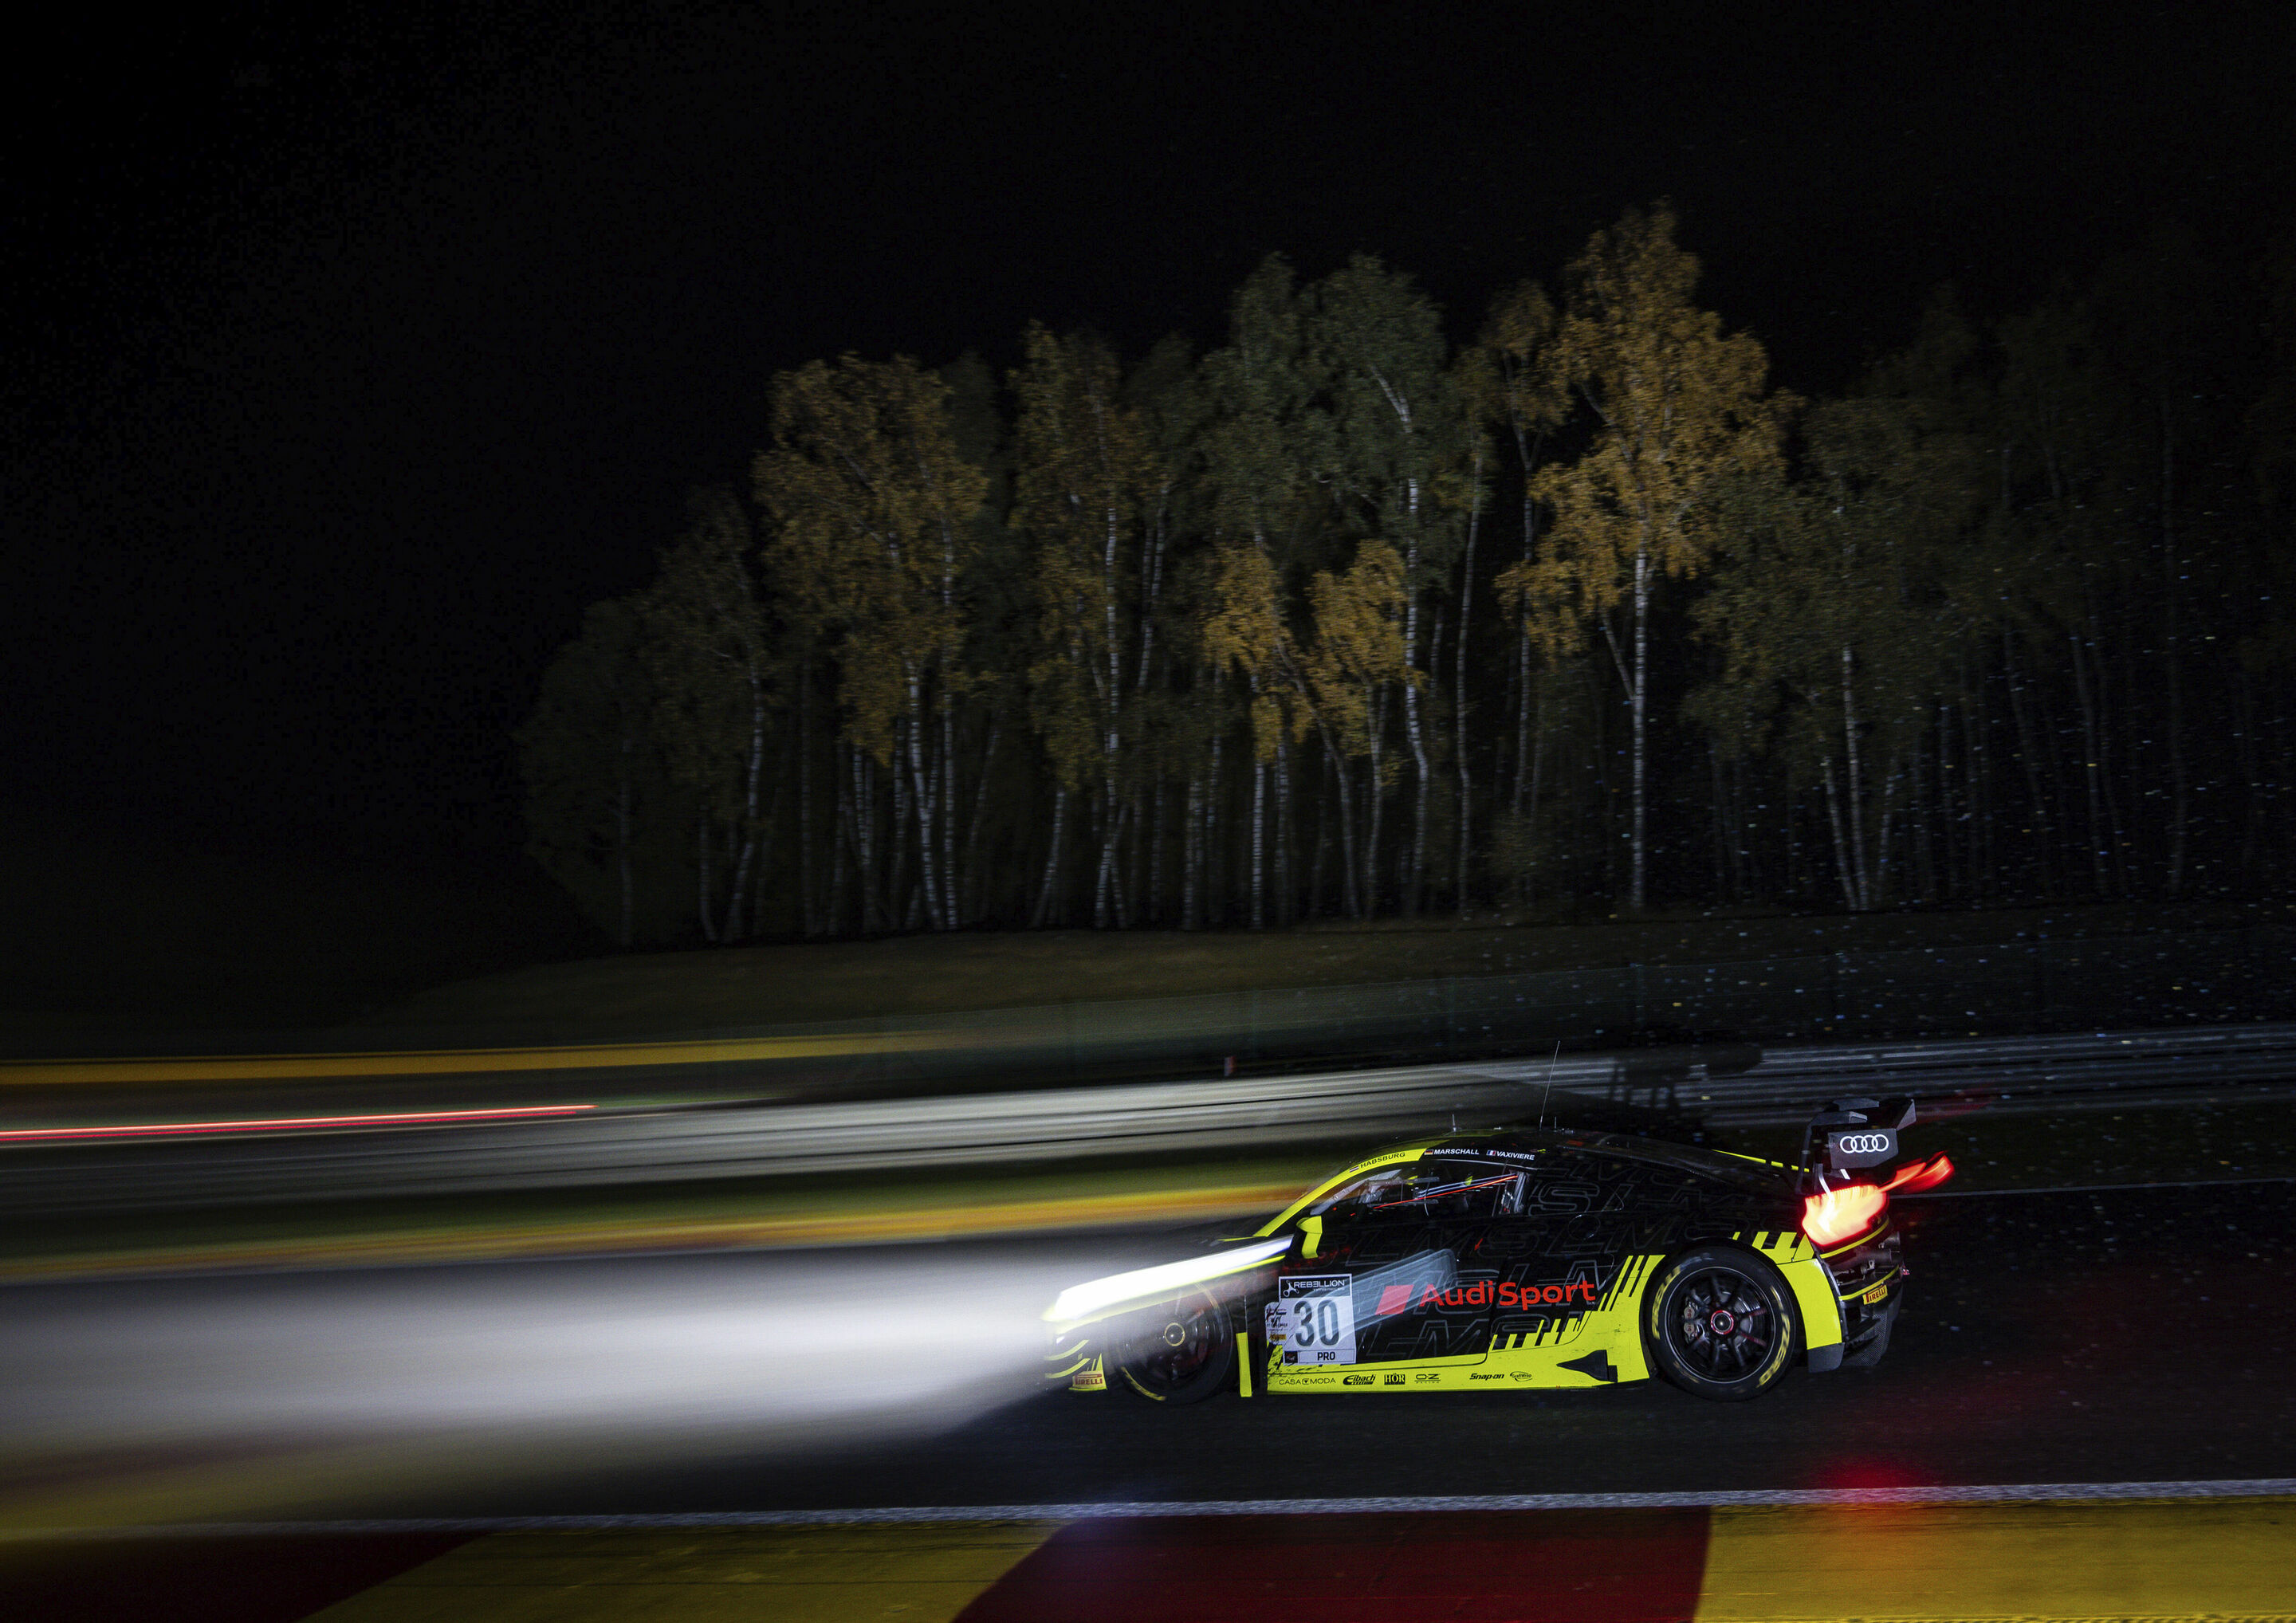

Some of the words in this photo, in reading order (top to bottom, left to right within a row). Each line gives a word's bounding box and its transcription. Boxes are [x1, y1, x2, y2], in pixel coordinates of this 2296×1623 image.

[1360, 1152, 1406, 1169] HABSBURG
[1496, 1150, 1535, 1161] VAXIVIERE
[1293, 1279, 1345, 1288] REBELLION
[1866, 1283, 1886, 1303] PIRELLI
[1293, 1299, 1340, 1347] 30
[1317, 1351, 1336, 1361] PRO
[1075, 1373, 1103, 1385] PIRELLI
[1343, 1373, 1377, 1385] Eibach
